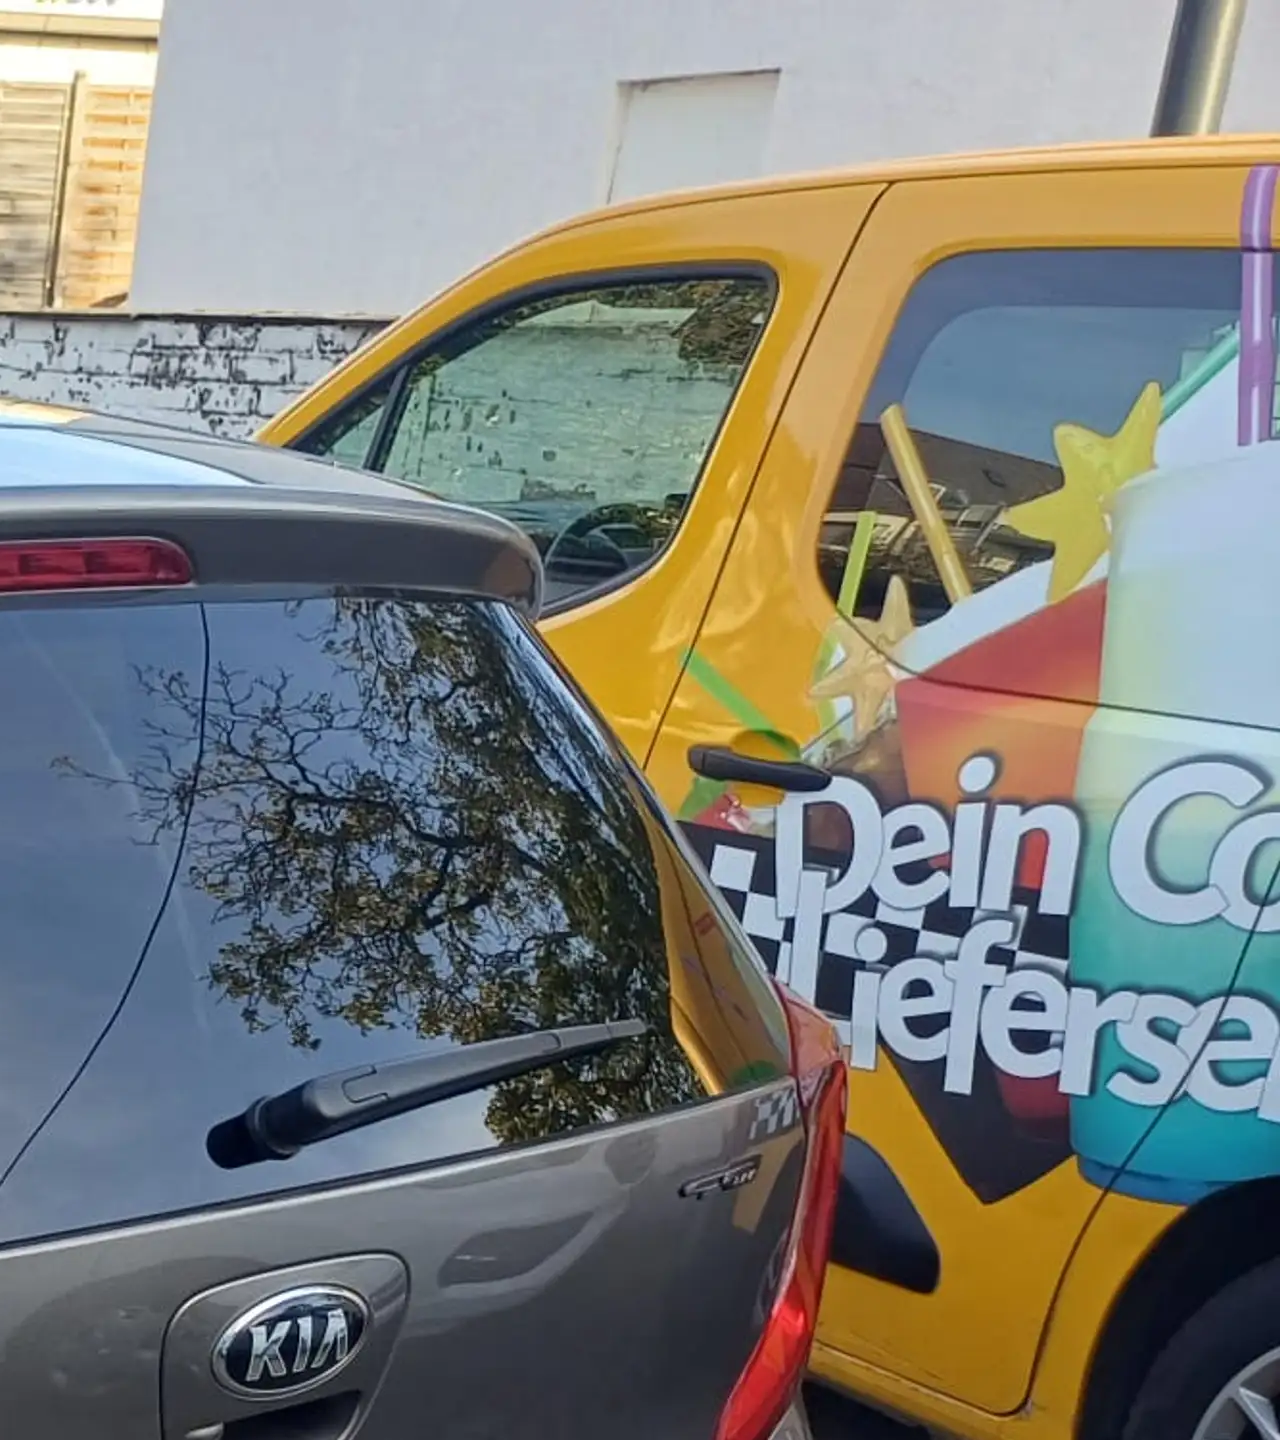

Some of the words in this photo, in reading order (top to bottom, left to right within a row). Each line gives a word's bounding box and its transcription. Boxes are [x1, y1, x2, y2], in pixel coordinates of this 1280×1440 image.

[775, 755, 1081, 919] Dein
[787, 869, 1280, 1122] Lieferse
[245, 1307, 349, 1382] KIA
